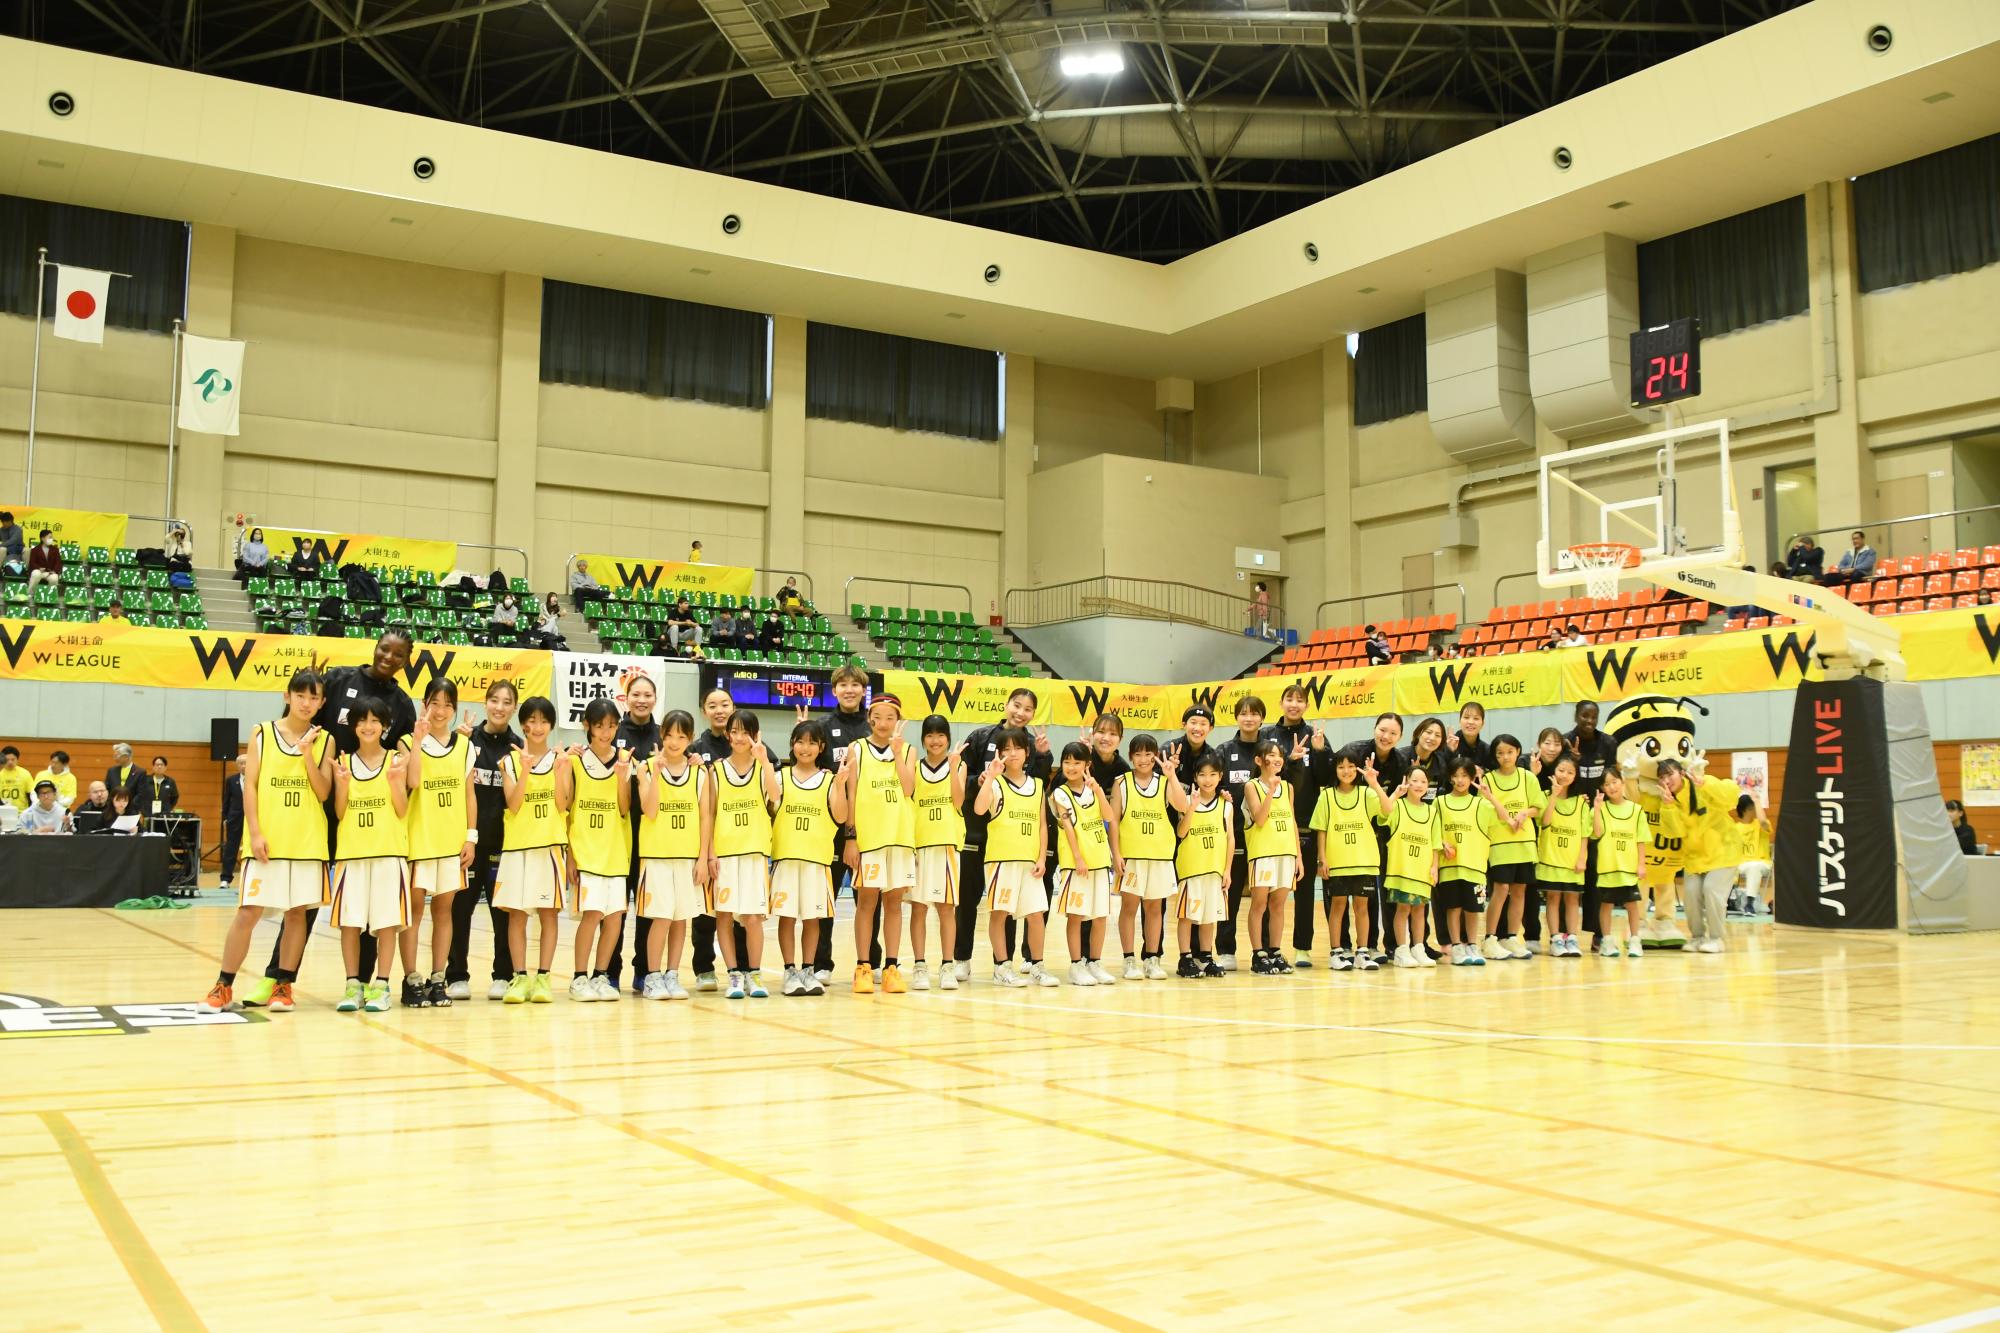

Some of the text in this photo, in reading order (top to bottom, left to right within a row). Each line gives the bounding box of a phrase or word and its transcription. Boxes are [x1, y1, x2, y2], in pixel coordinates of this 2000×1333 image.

[1646, 352, 1689, 399] 24
[615, 563, 665, 591] W
[1687, 574, 1716, 590] Senoh
[54, 635, 103, 646] 大樹生命
[56, 653, 121, 669] LEAGUE
[189, 635, 257, 682] W
[472, 660, 513, 671] 大樹生命
[1587, 646, 1638, 693] W
[1652, 667, 1703, 684] LEAGUE
[782, 674, 810, 682] INTERVAL
[1429, 662, 1473, 706] W
[776, 682, 814, 698] 40:40
[918, 676, 964, 715] W
[1482, 681, 1525, 697] LEAGUE
[1069, 685, 1110, 720] W
[1339, 692, 1375, 706] LEAGUE
[978, 701, 1006, 713] LEAG
[1122, 707, 1159, 720] LEAGUE
[271, 777, 309, 788] QUEENBEE
[284, 792, 300, 808] 00
[350, 798, 386, 808] UEENBEES
[438, 791, 452, 808] 00
[525, 790, 555, 802] QUEENBEE
[534, 803, 548, 819] 00
[579, 800, 616, 810] QUEENBEES
[358, 812, 374, 827] 00
[590, 813, 604, 829] 00
[735, 813, 749, 827] 00
[929, 808, 942, 821] 00
[671, 815, 685, 830] 00
[795, 817, 810, 831] 00
[1142, 822, 1154, 835] 00
[1202, 836, 1214, 849] 00
[1344, 833, 1356, 845] 00
[1409, 845, 1420, 858] 00
[864, 864, 880, 881] 13
[248, 879, 262, 897] 5
[719, 887, 731, 904] 0
